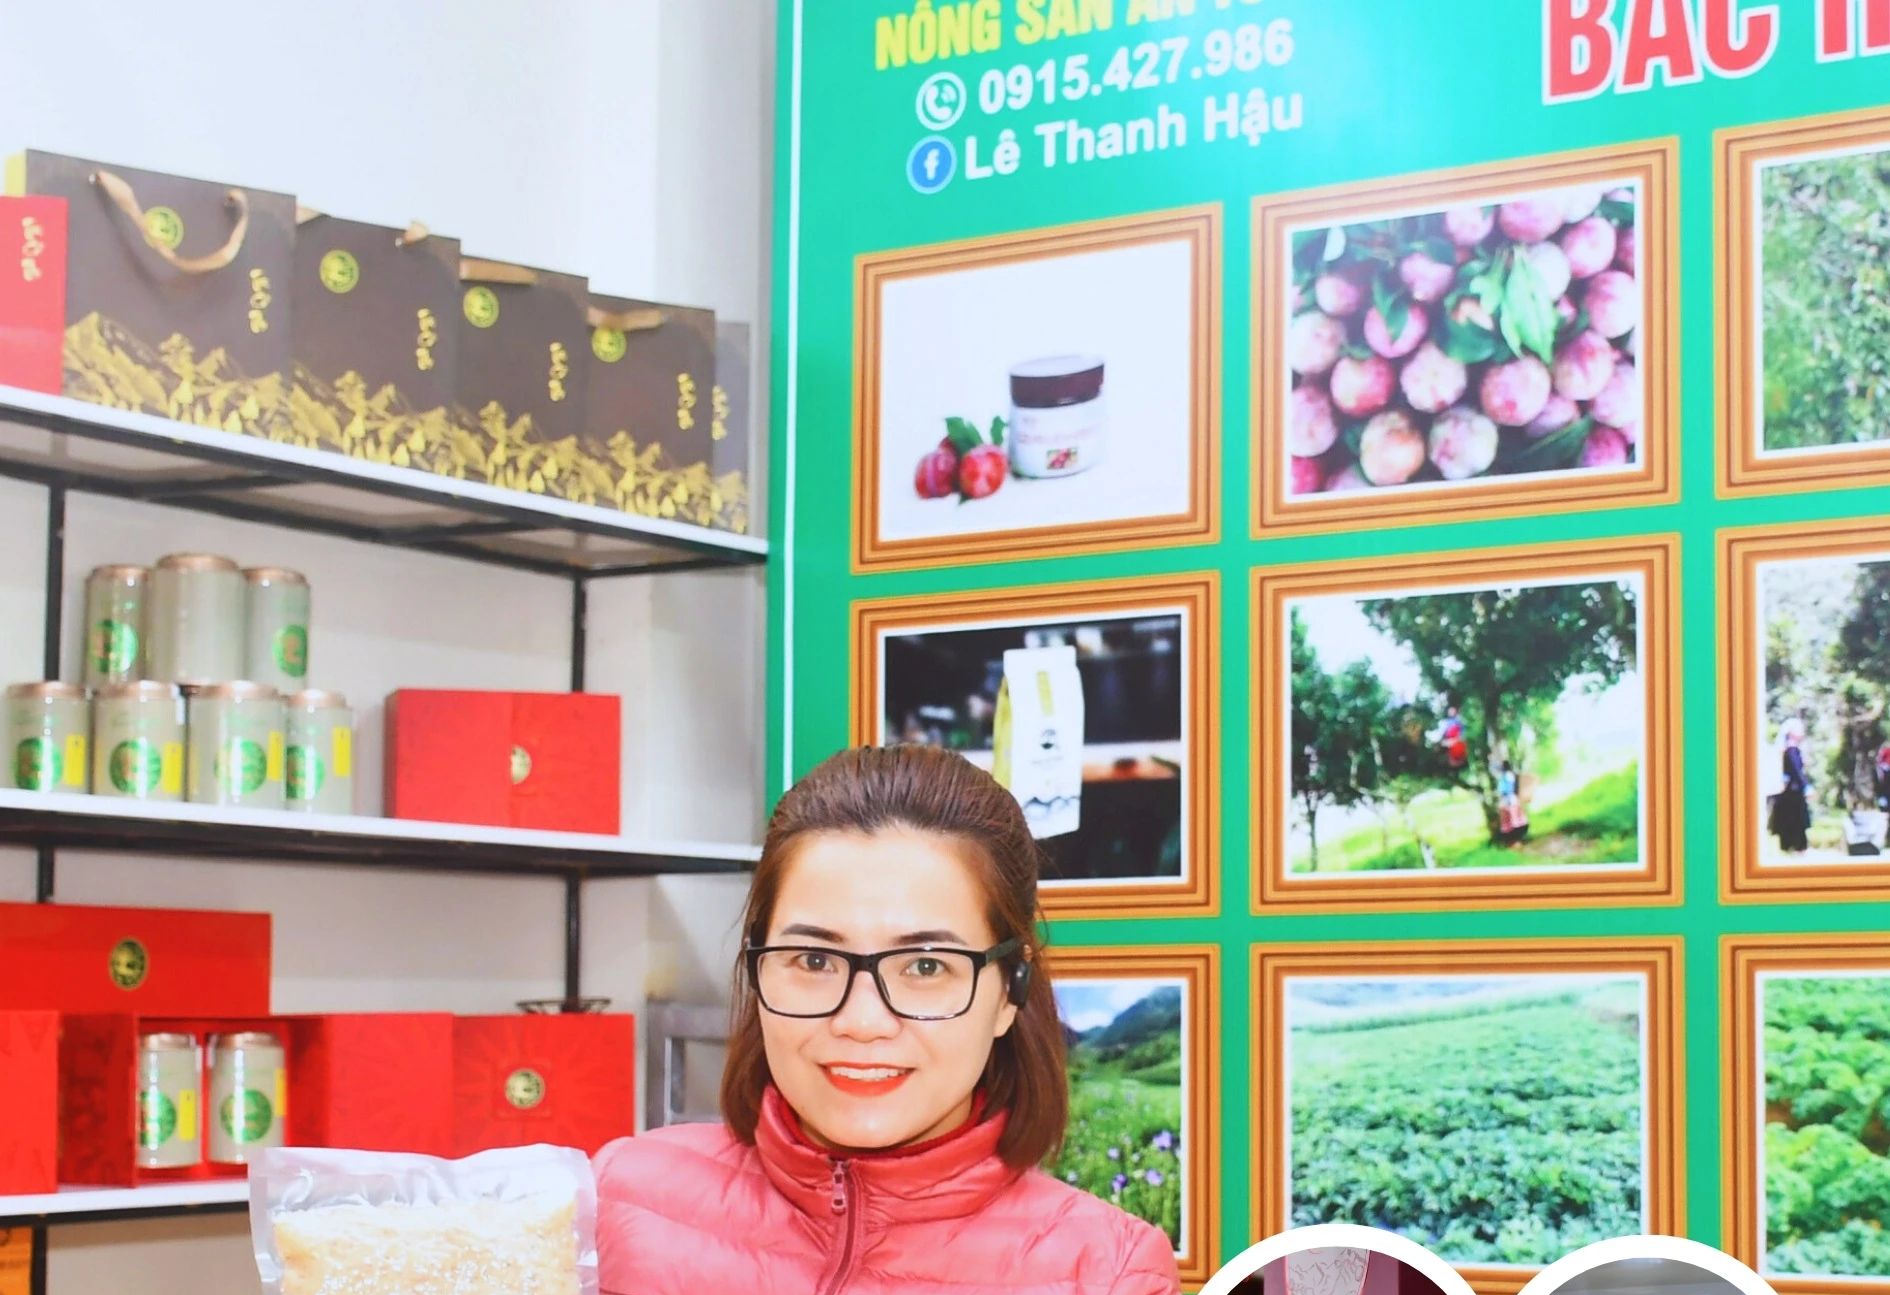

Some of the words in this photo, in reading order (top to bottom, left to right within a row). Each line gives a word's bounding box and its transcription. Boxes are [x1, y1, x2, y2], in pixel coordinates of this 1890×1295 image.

[875, 0, 1001, 70] NÔNG
[979, 18, 1296, 115] 0915.427.986
[964, 128, 1022, 181] Lê
[1033, 103, 1188, 168] Thanh
[1202, 87, 1304, 147] Hậu
